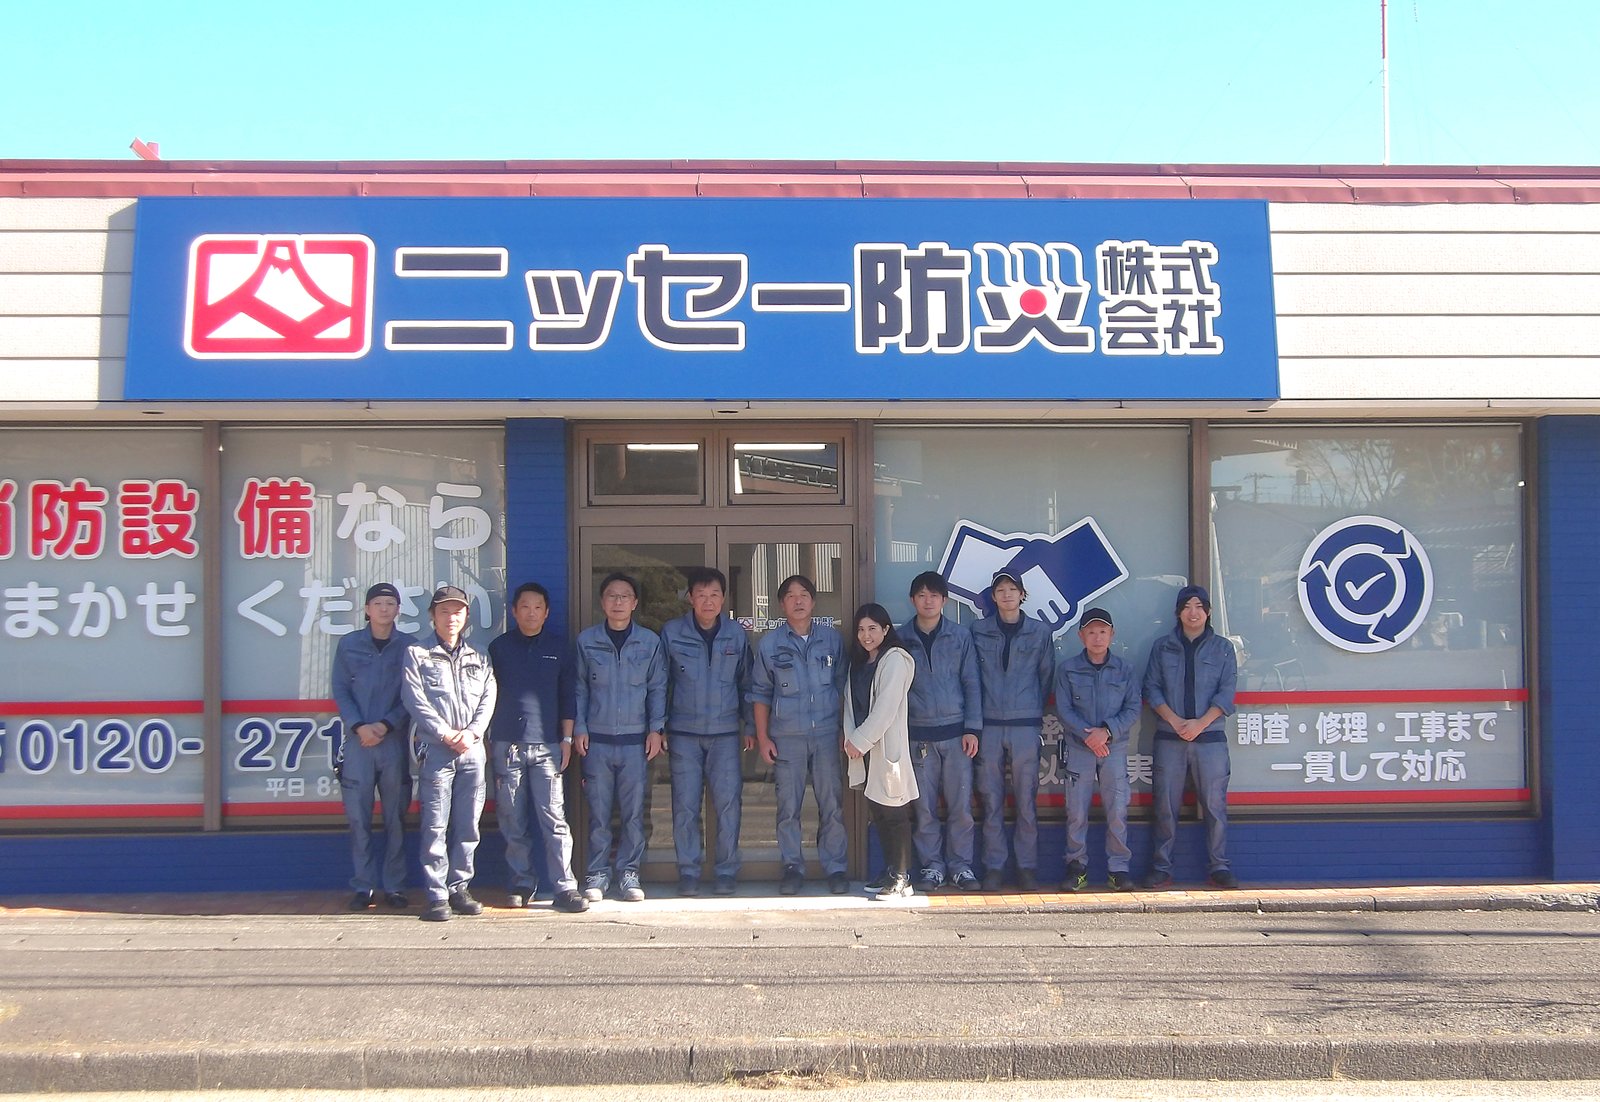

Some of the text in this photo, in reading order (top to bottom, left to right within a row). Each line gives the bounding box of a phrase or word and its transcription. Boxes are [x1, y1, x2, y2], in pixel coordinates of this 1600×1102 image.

[1271, 749, 1467, 783] 一貫して対応
[265, 777, 305, 797] 平日
